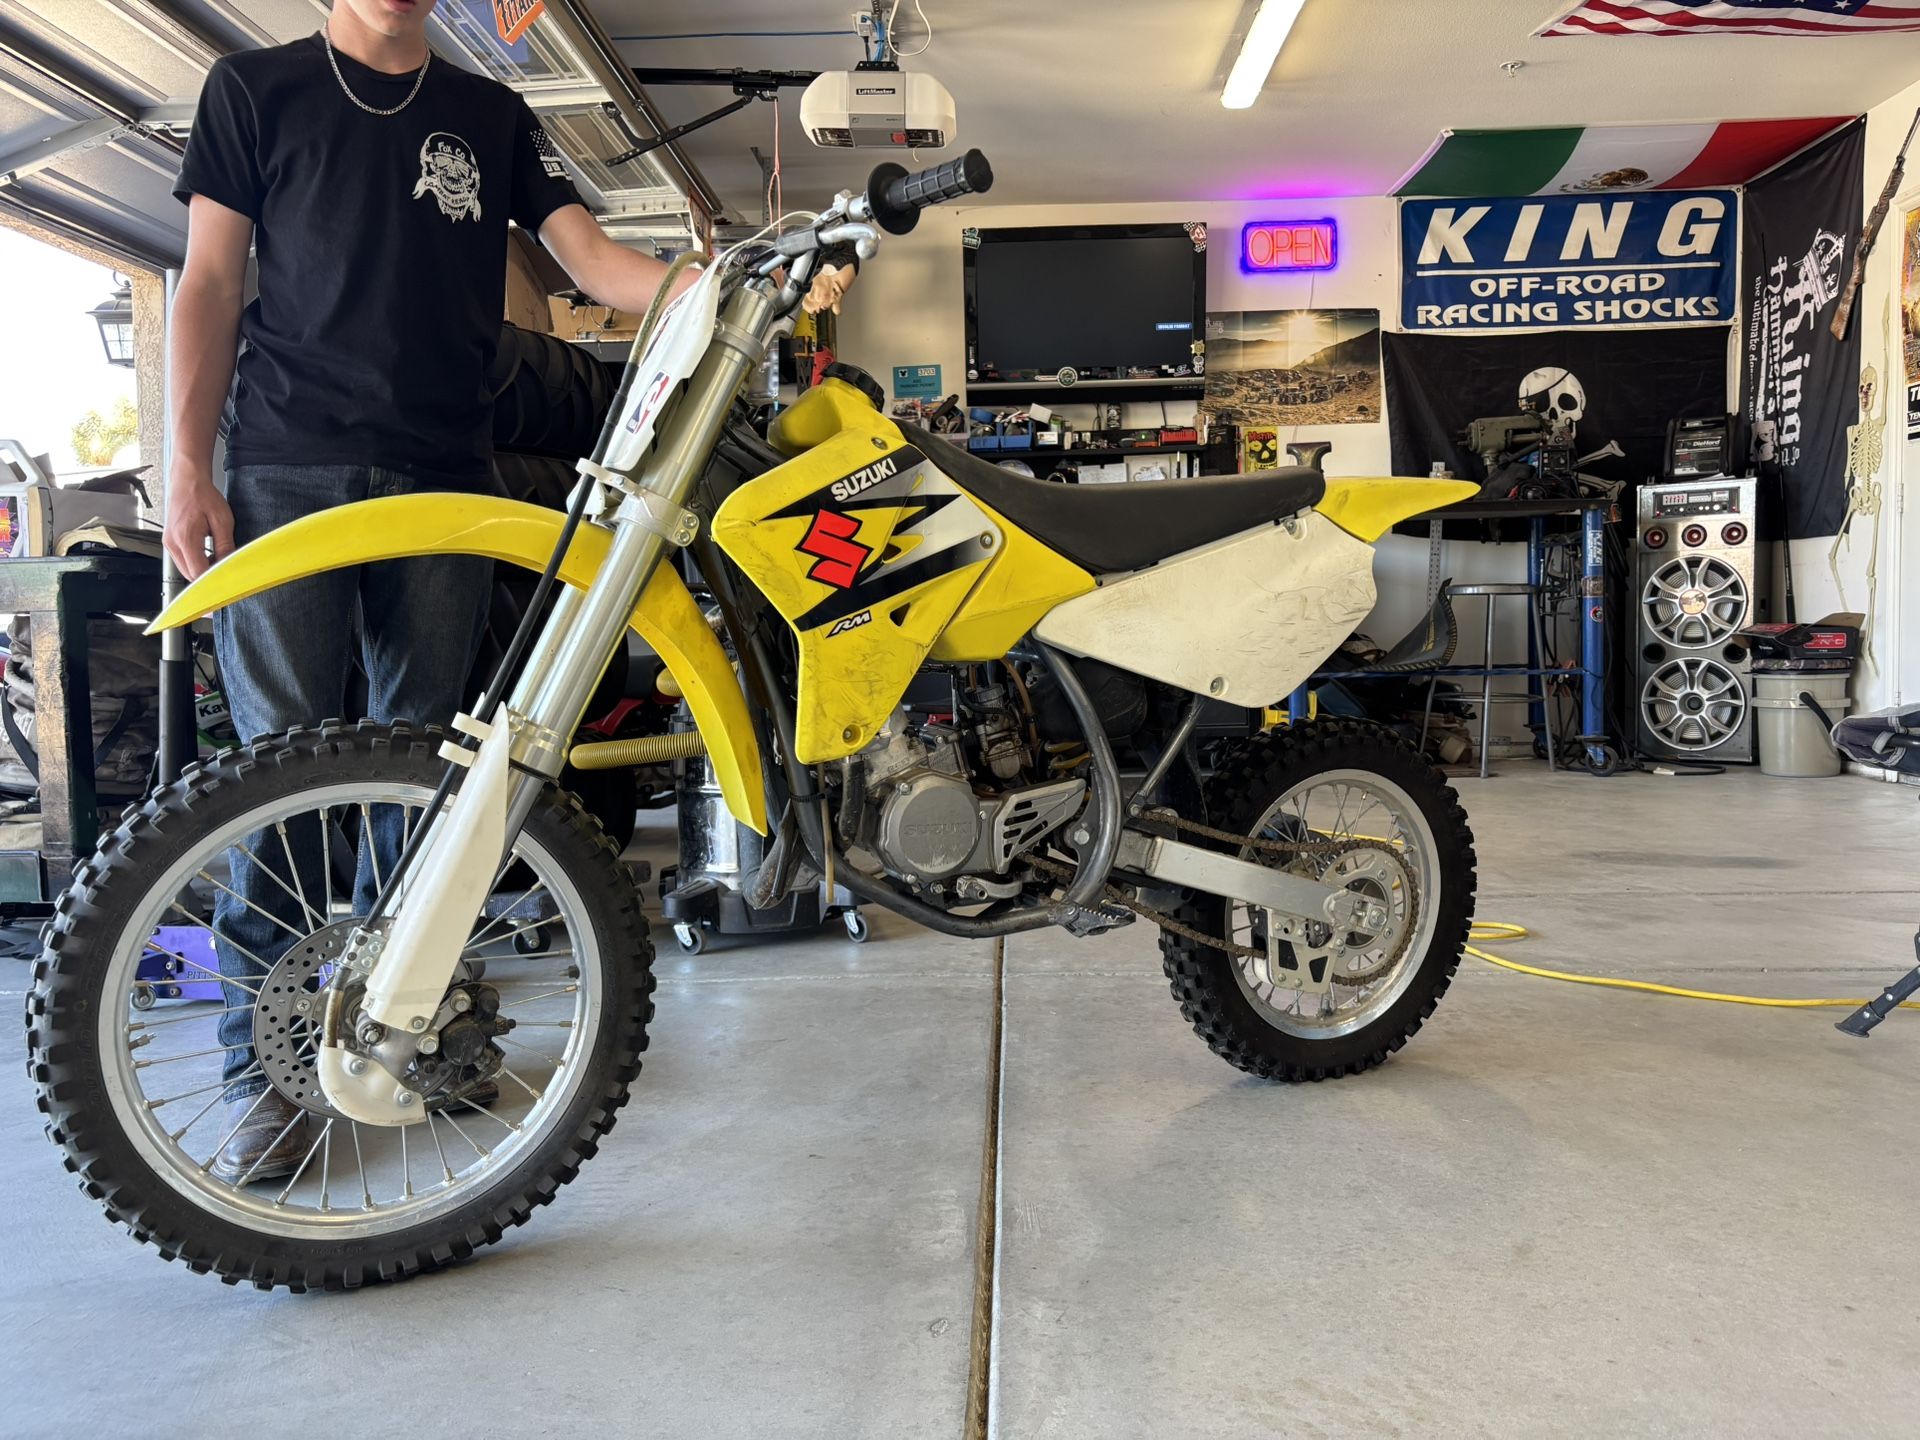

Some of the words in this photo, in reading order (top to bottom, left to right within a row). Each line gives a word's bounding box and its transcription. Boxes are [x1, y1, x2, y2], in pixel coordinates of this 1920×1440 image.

[1416, 196, 1726, 265] KING
[1248, 226, 1331, 267] OPEN
[1469, 272, 1666, 298] OFF-ROAD
[1416, 302, 1559, 327] RACING
[1573, 296, 1720, 322] SHOCKS
[1693, 439, 1720, 447] DieHard
[831, 457, 897, 502] SUZUKI
[828, 611, 871, 637] RM
